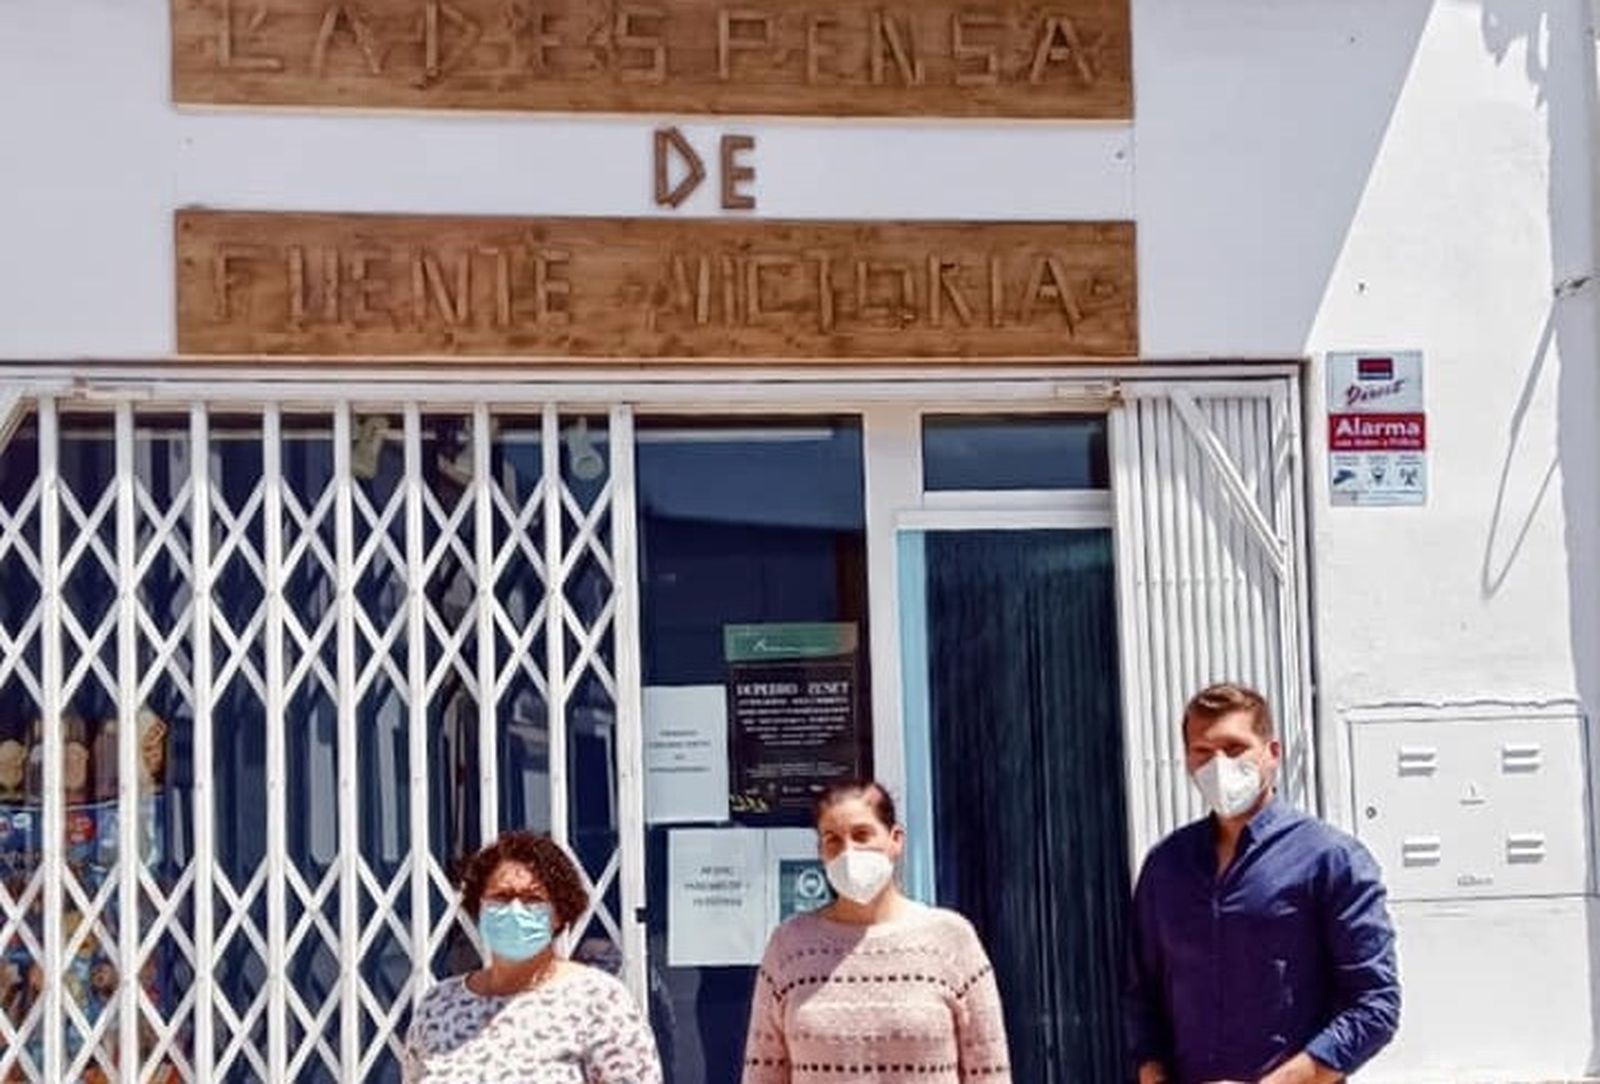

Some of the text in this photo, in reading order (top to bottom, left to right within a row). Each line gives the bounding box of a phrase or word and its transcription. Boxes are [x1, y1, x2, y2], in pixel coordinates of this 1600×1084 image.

[653, 126, 757, 210] DE
[213, 243, 1084, 336] FUENTE VICTORIA
[1336, 416, 1421, 437] Alarma
